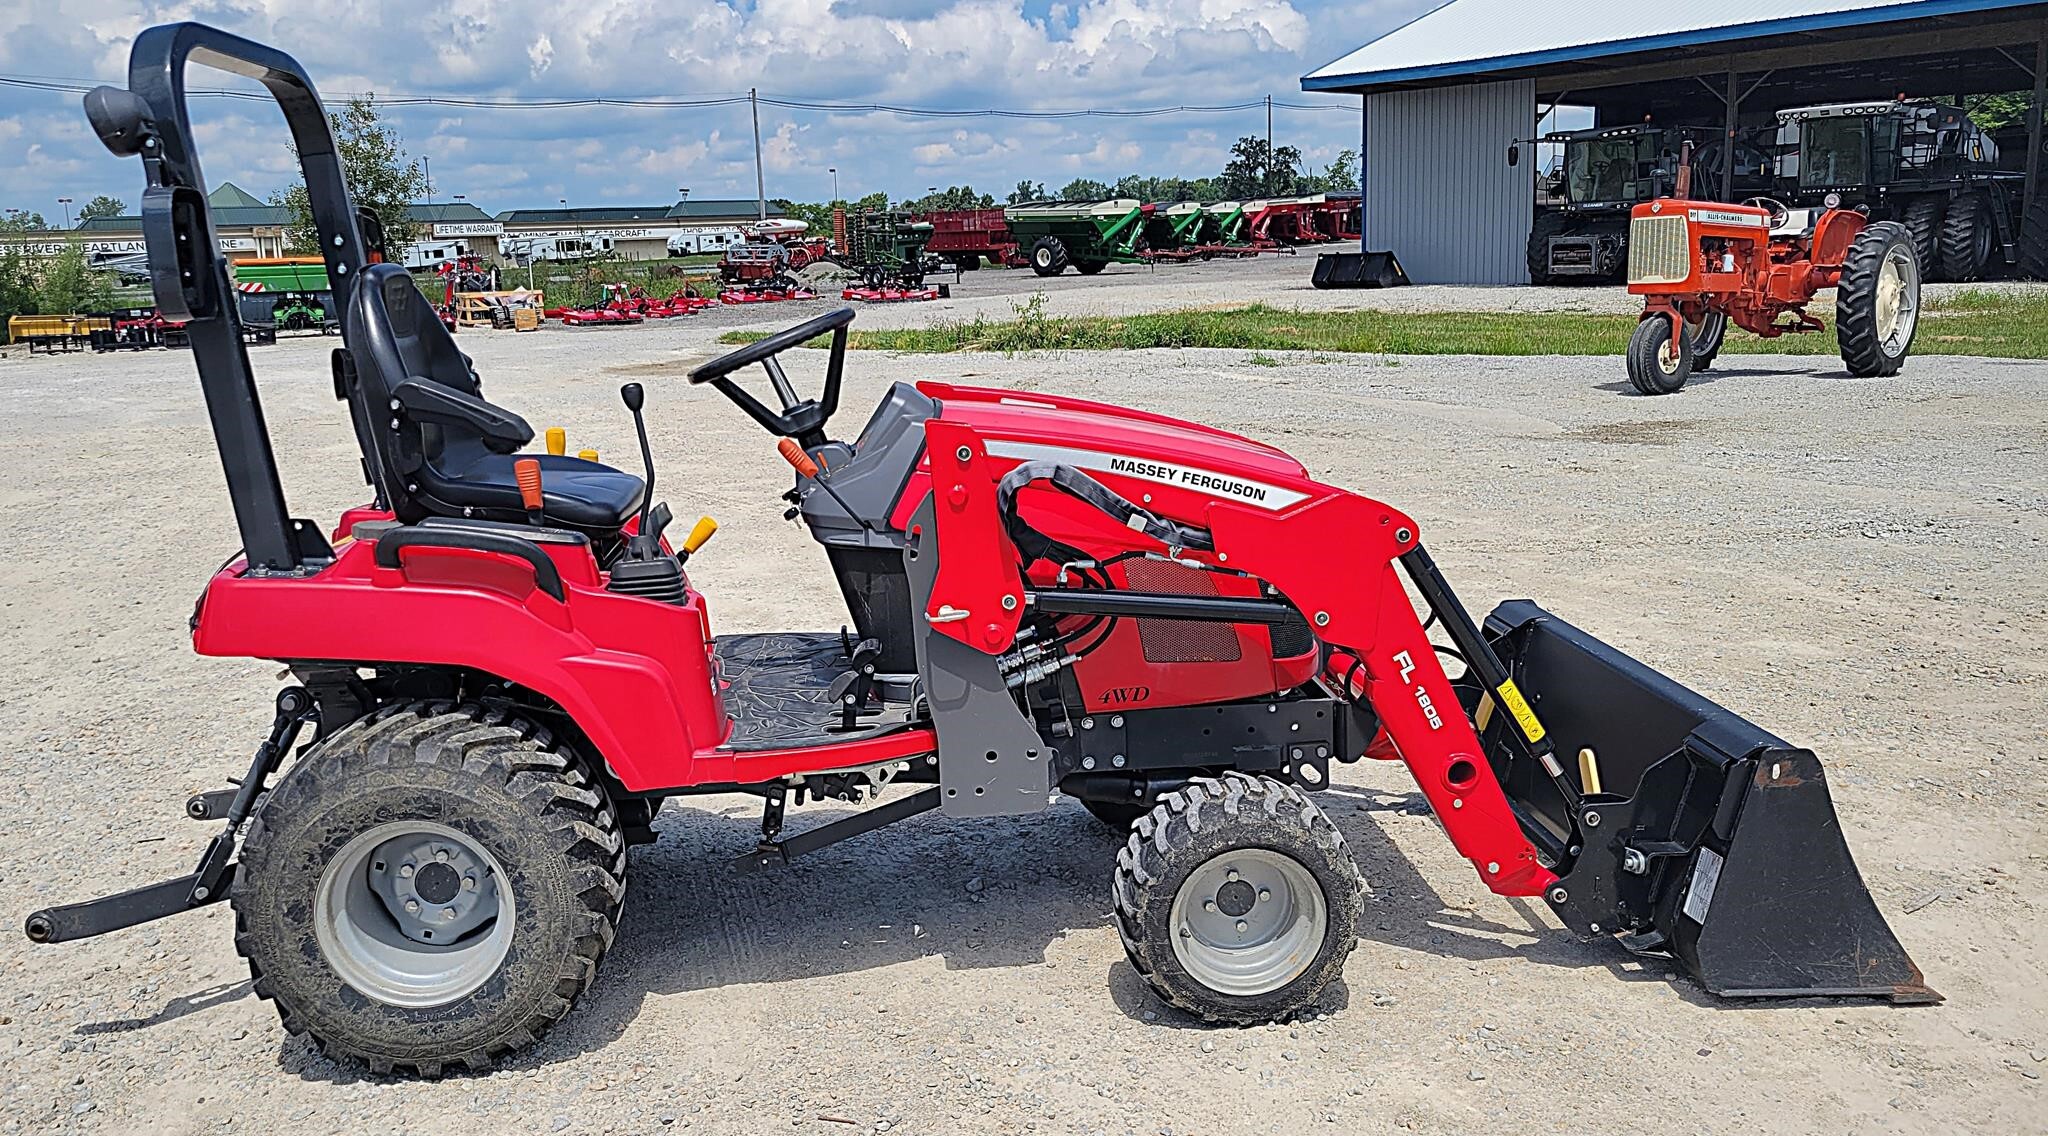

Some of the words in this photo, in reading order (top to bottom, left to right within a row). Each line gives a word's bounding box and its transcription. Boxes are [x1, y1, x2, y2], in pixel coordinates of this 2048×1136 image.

[1707, 213, 1743, 222] ALLIS-CHALMERS
[435, 225, 465, 234] LIFETIME
[465, 224, 503, 233] WARRANTY
[80, 241, 146, 253] EARTLAN
[1110, 458, 1178, 481] MASSEY
[1181, 471, 1267, 501] FERGUSON
[1098, 686, 1150, 704] 4WD
[1392, 650, 1416, 685] FL
[1414, 685, 1444, 730] 1805
